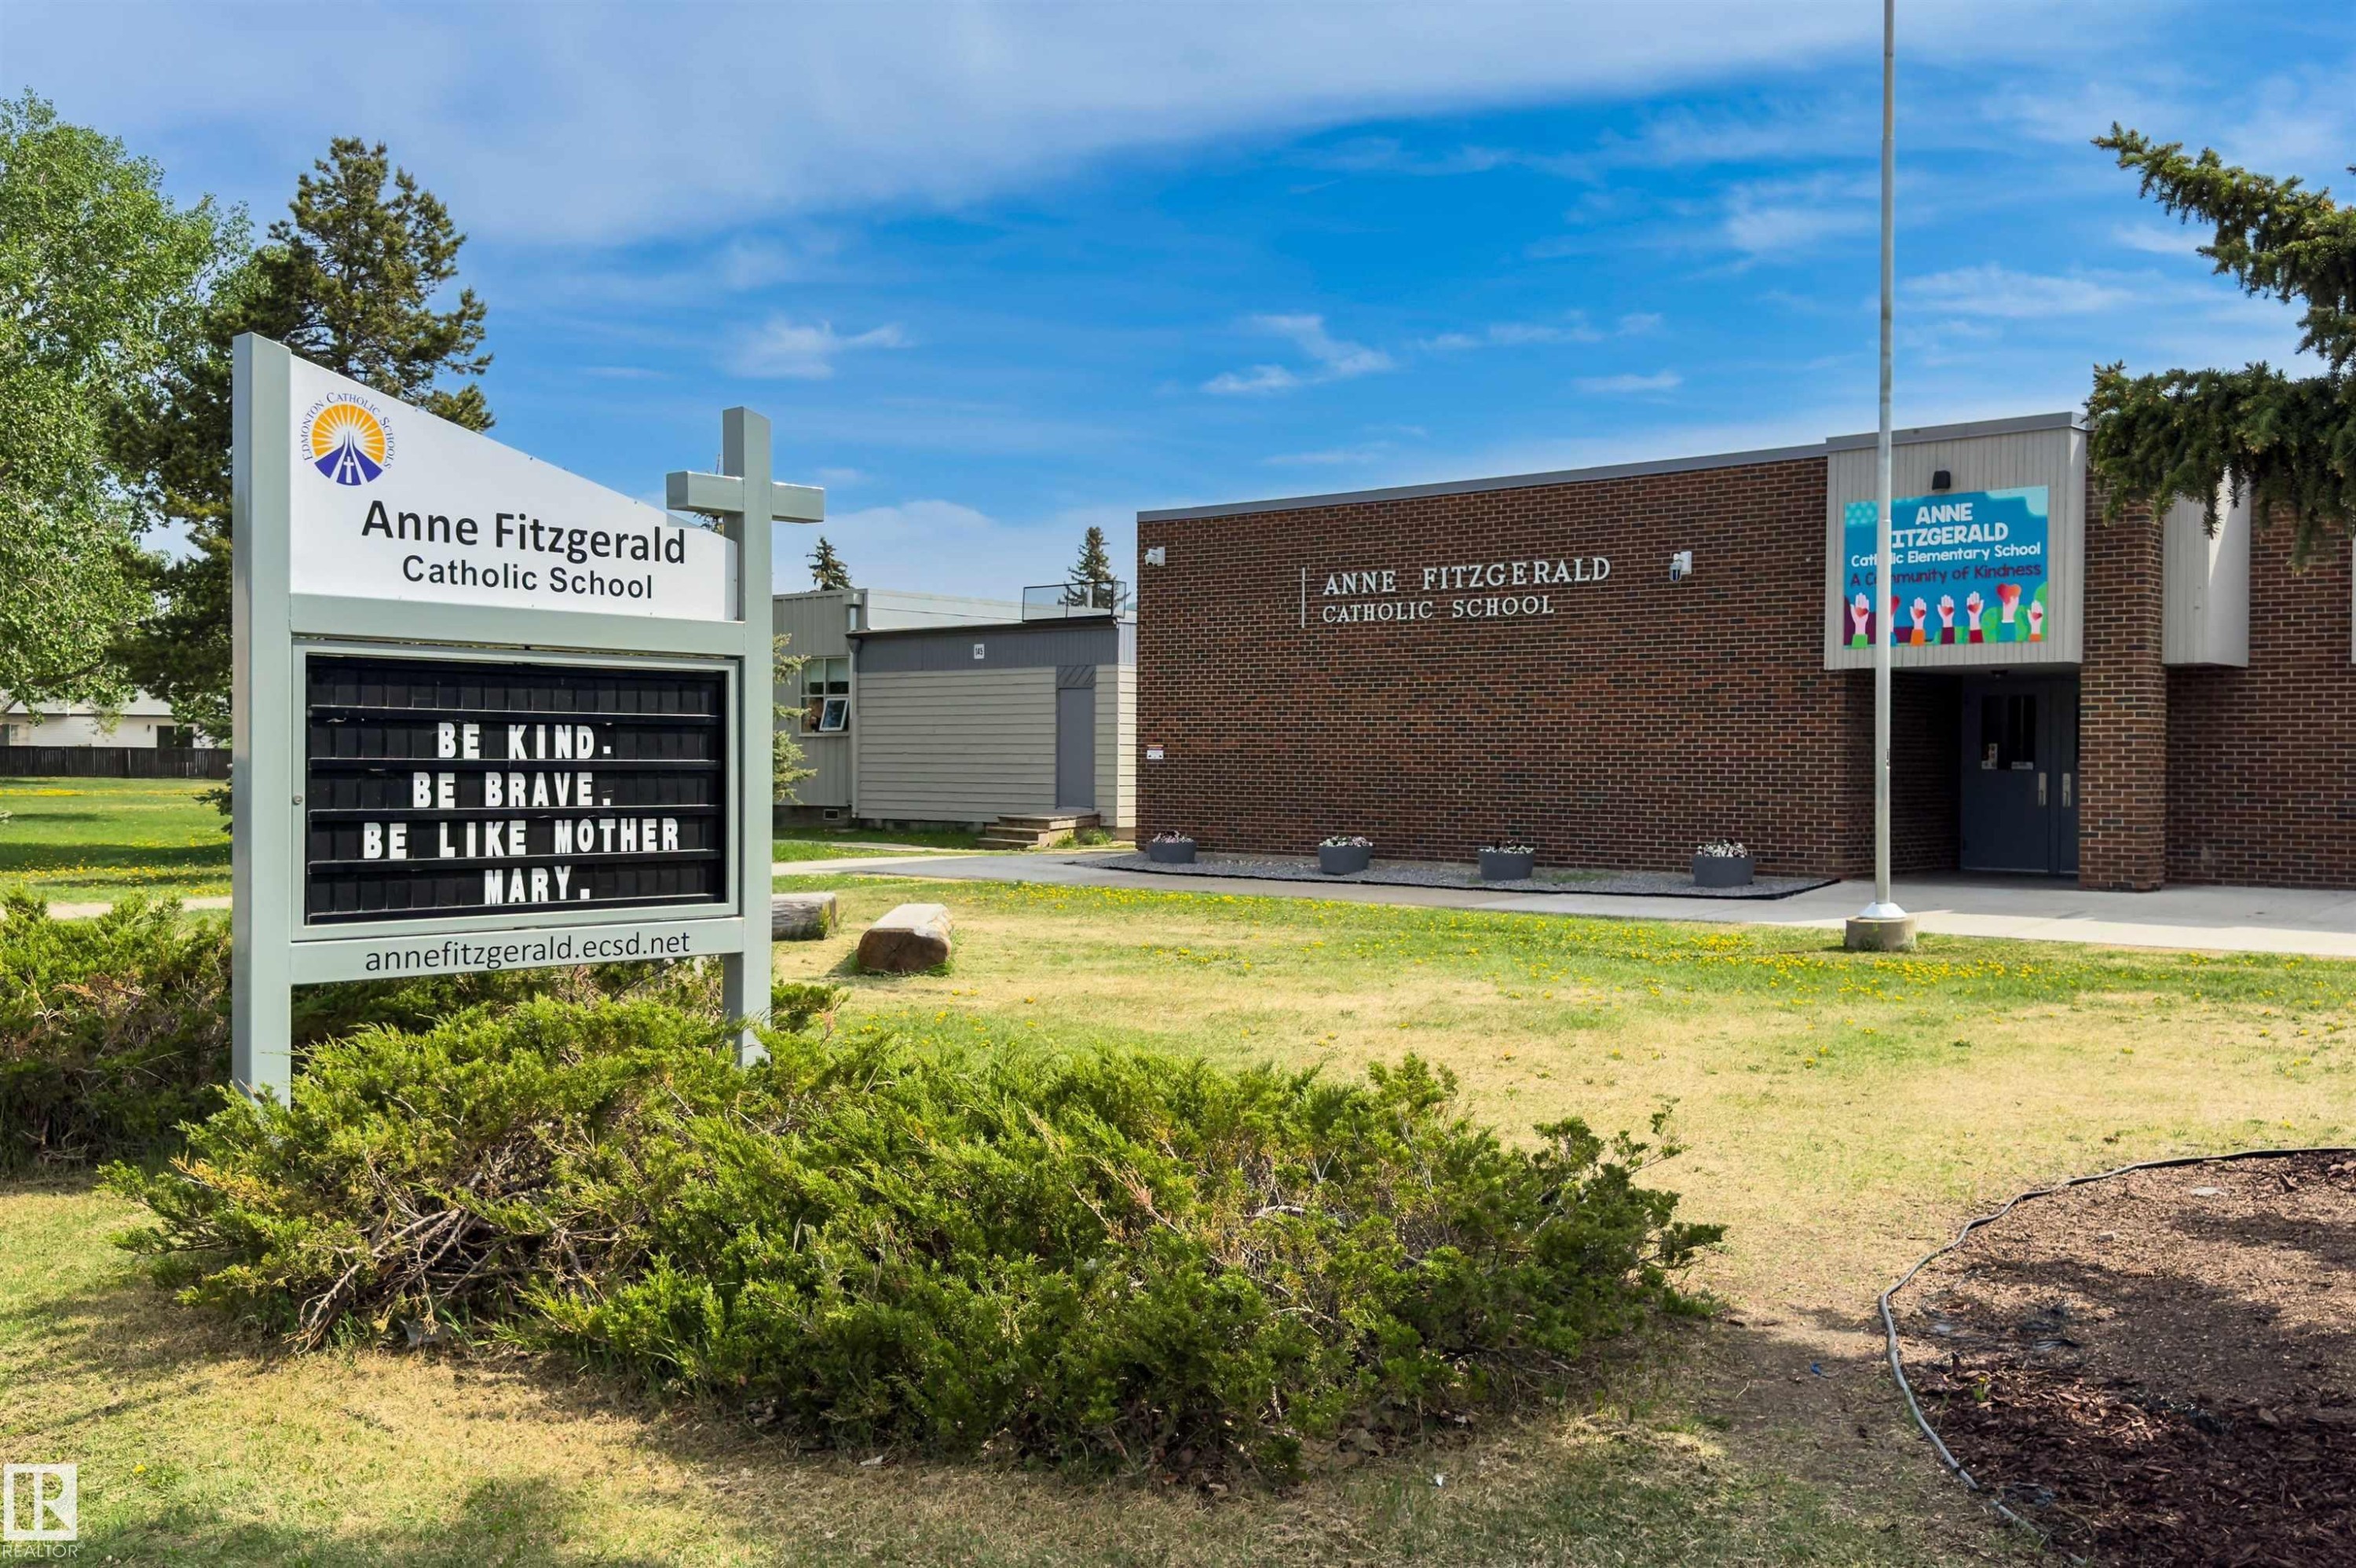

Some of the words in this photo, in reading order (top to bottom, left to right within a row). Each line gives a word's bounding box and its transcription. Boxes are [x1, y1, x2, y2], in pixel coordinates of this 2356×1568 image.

[300, 400, 324, 461] EDMONTON
[326, 392, 380, 416] CATHOLIC
[380, 416, 396, 470] SCHOOLS
[362, 500, 478, 546] Anne
[496, 512, 686, 565] Fitzgerald
[1915, 503, 1973, 525] ANNE
[1891, 522, 2009, 549] ITZGERALD
[1851, 550, 1903, 568] Catic
[1908, 546, 1990, 565] Elementary
[1995, 542, 2040, 558] School
[403, 554, 537, 590] Catholic
[550, 566, 653, 599] School
[1323, 570, 1396, 595] ANNE
[1423, 557, 1611, 590] FITZGERALD
[1850, 573, 1861, 587] A
[1865, 567, 1948, 587] Cmmunity
[1952, 568, 1970, 580] of
[1974, 562, 2042, 579] Kindness
[1323, 601, 1433, 623] CATHOLIC
[1452, 595, 1554, 618] SCHOOL
[437, 722, 481, 759] BE
[509, 724, 612, 759] KIND.
[413, 772, 455, 809] BE
[485, 772, 612, 808] BRAVE.
[363, 823, 408, 860] BE
[439, 821, 526, 858] LIKE
[554, 818, 679, 853] MOTHER
[485, 865, 591, 905] MARY.
[365, 931, 690, 972] annefitzgerald.ecsd.net
